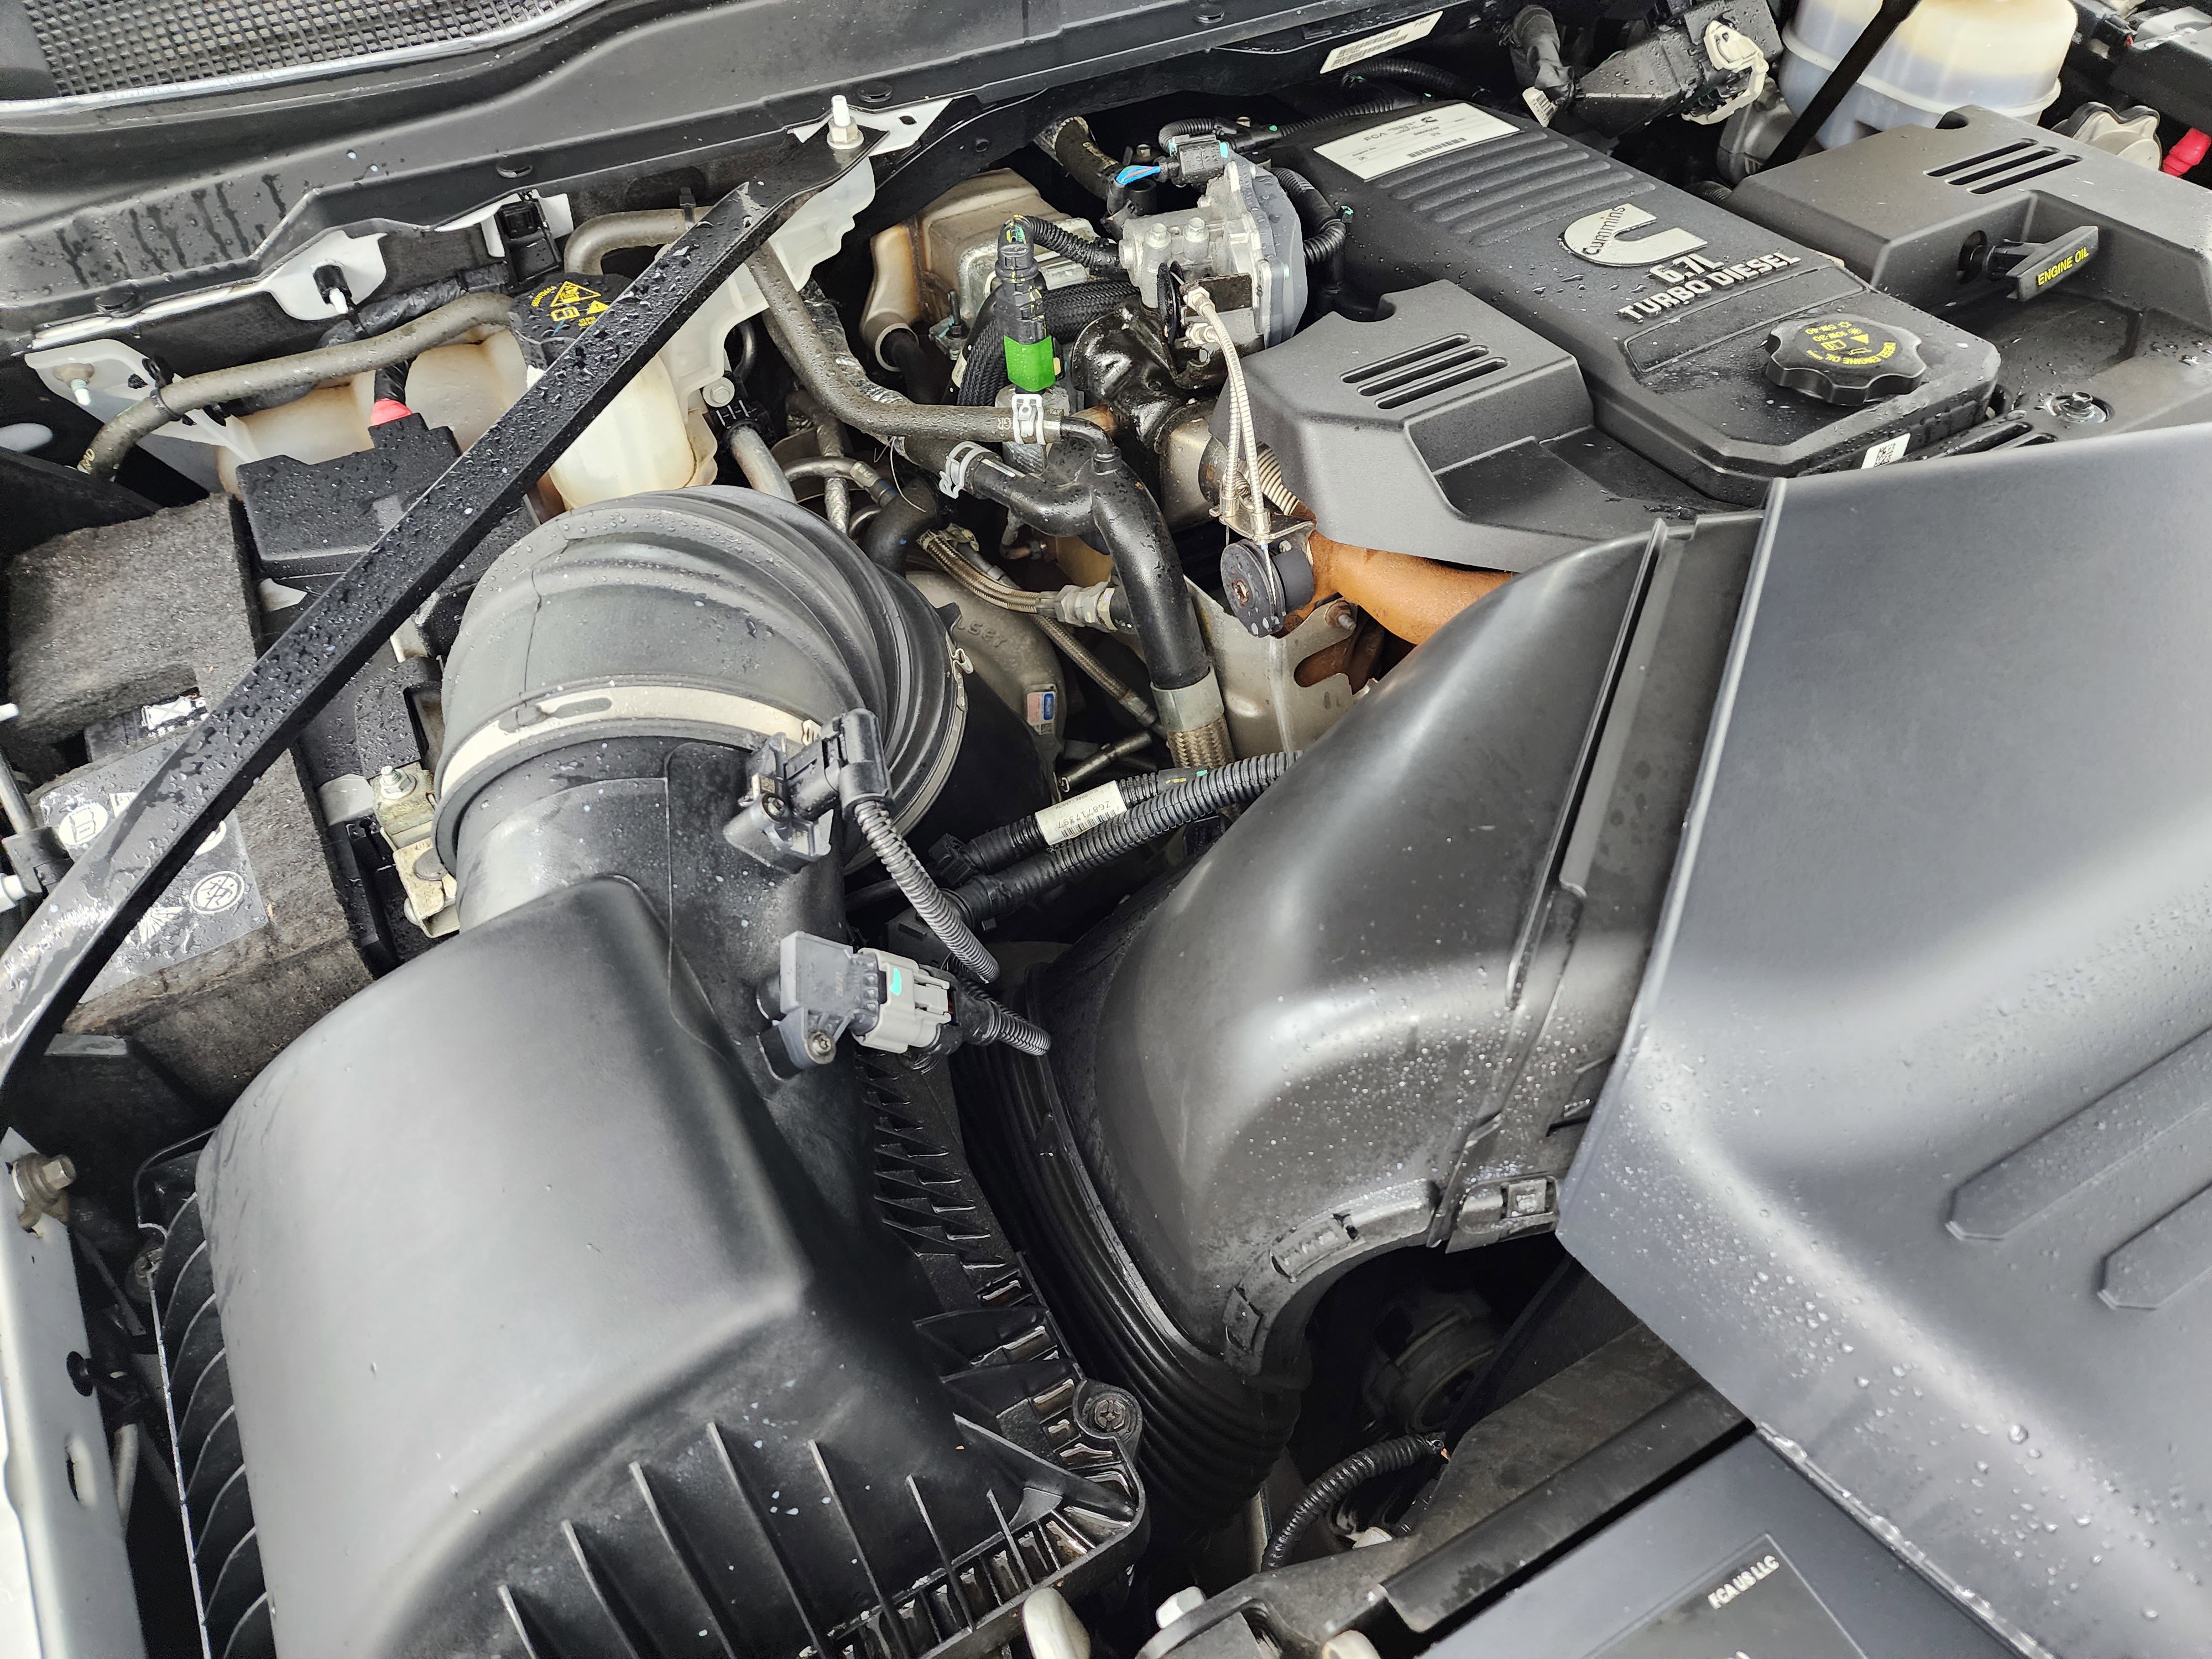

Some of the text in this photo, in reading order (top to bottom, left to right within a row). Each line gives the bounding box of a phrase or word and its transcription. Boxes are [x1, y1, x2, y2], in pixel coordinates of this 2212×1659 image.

[1649, 253, 1725, 284] 6.7L
[2037, 247, 2089, 286] ENGINE OIL
[1617, 252, 1802, 324] TURBO DIESEL
[1825, 352, 1841, 363] OIL
[1707, 1555, 1780, 1610] FCA US LLC
